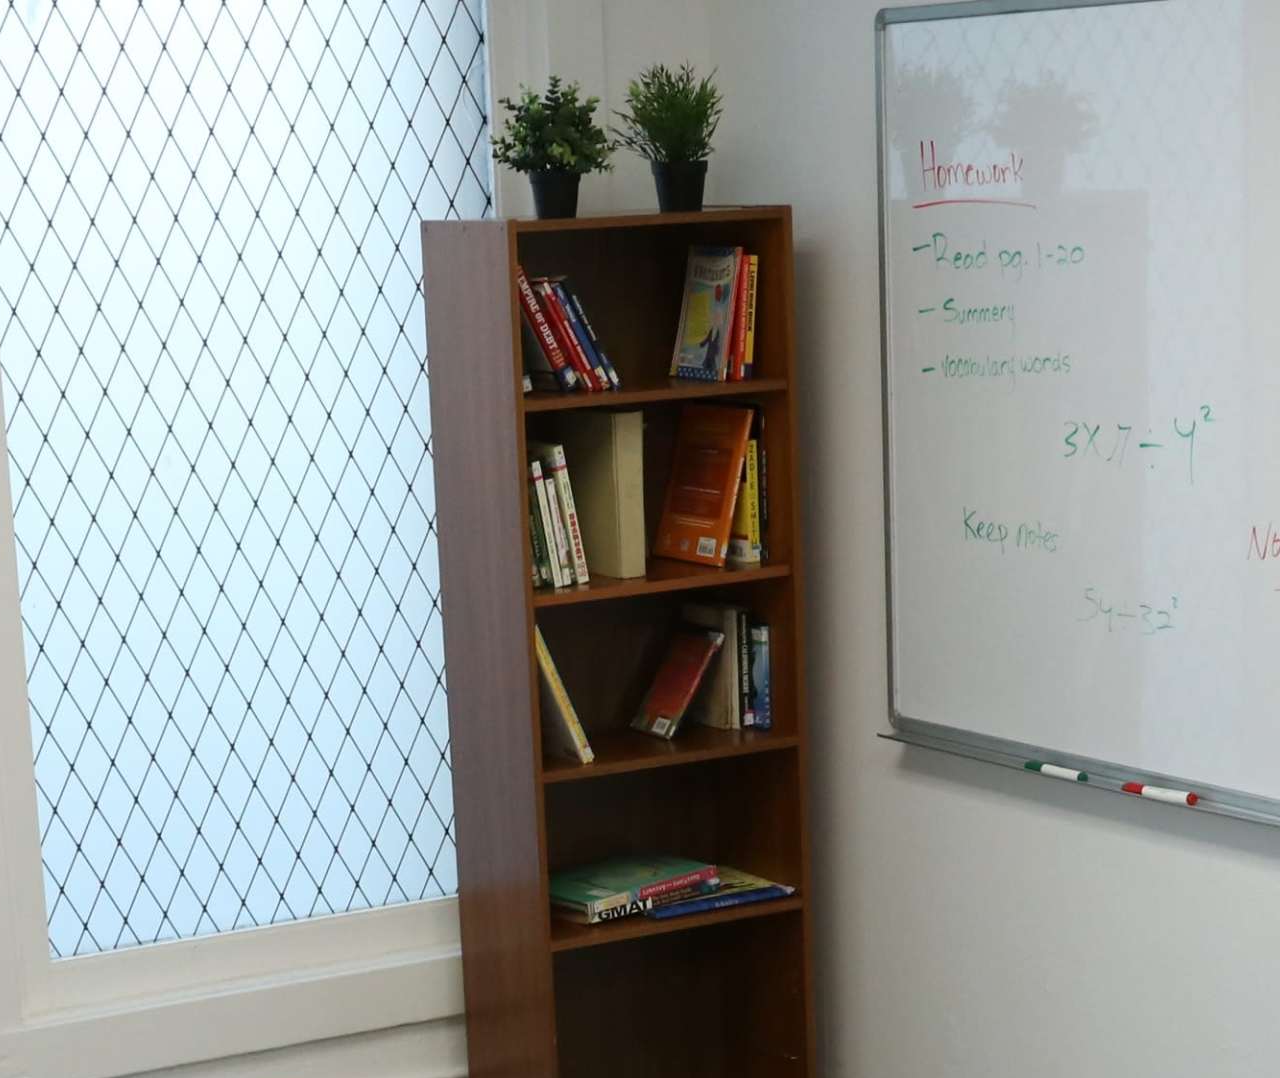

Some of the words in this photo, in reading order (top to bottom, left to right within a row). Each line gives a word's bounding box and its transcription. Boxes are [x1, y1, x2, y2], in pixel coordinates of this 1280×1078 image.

[920, 140, 1024, 193] Homework
[539, 324, 559, 350] DEBT
[963, 506, 1008, 553] Keep
[599, 897, 653, 921] GMAT
